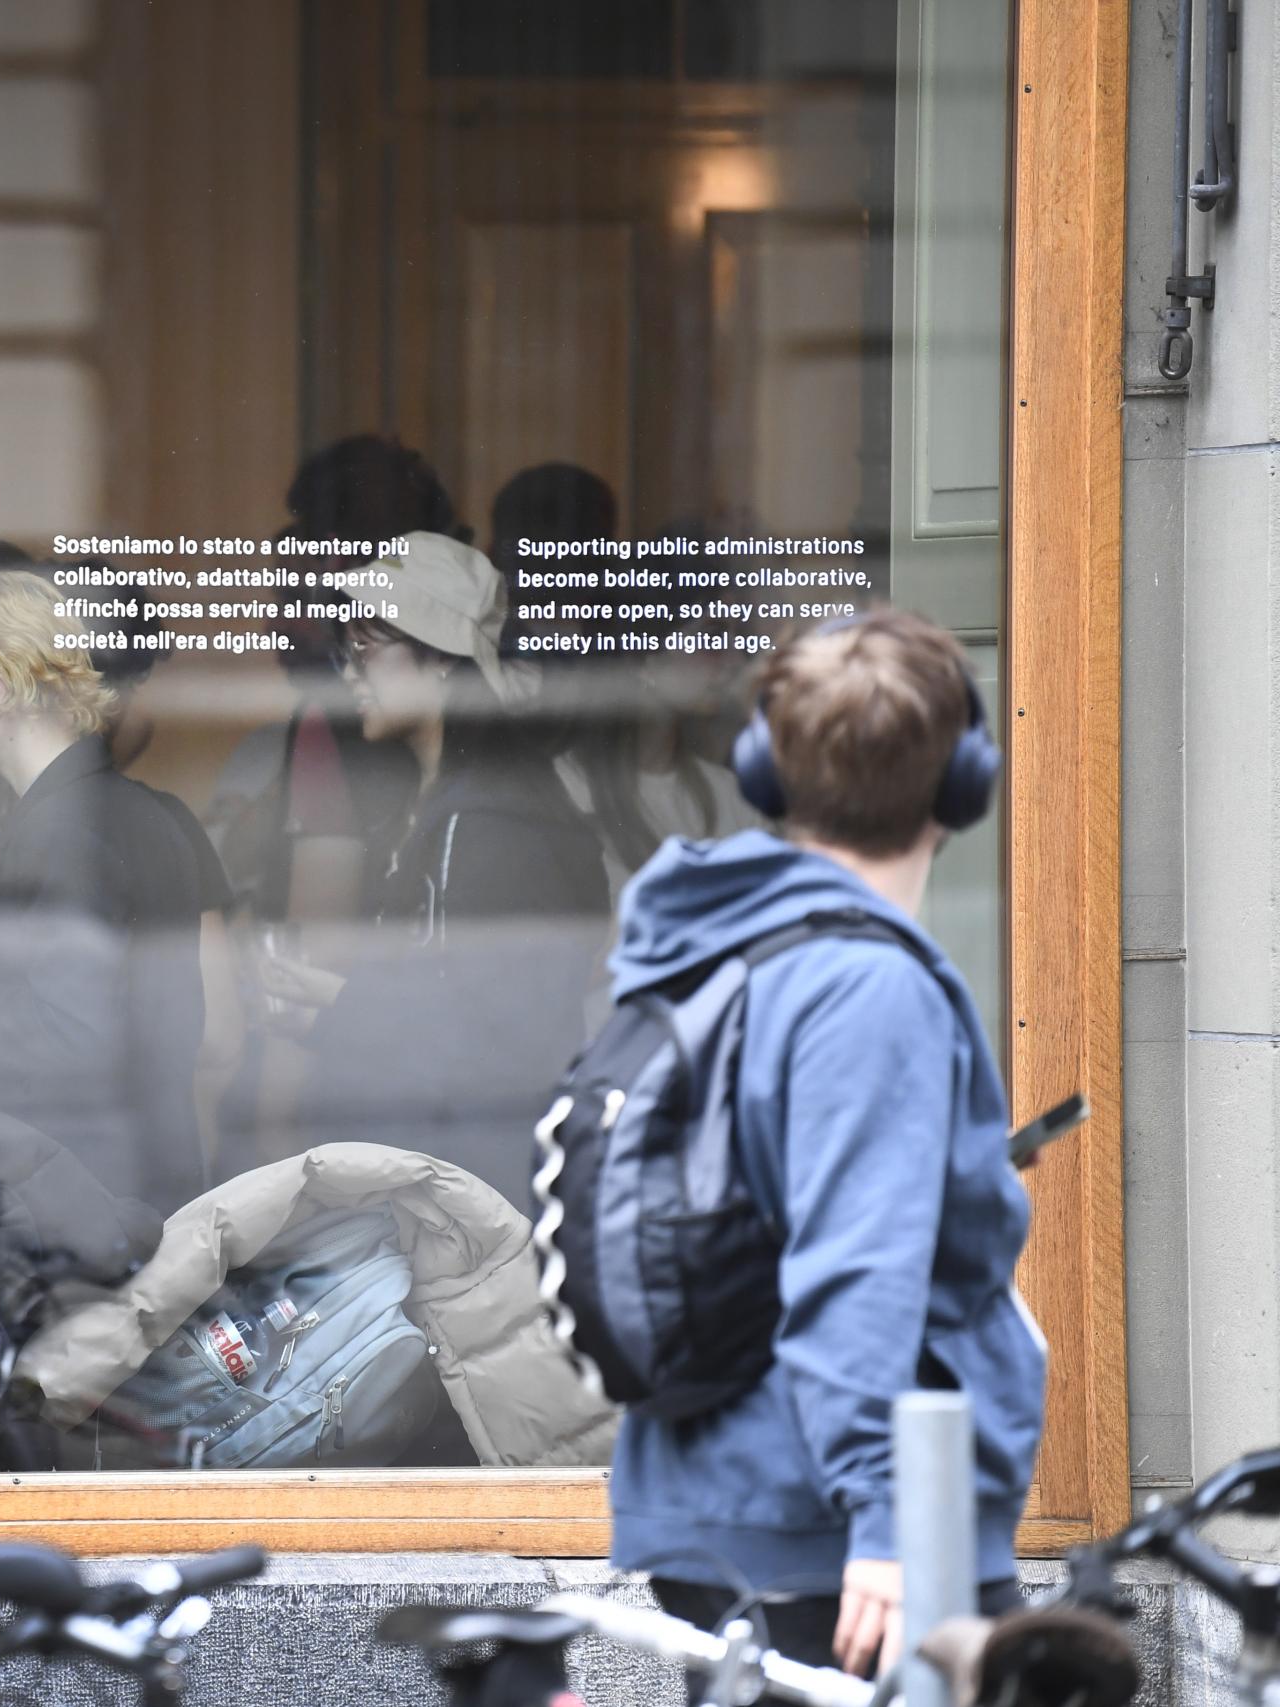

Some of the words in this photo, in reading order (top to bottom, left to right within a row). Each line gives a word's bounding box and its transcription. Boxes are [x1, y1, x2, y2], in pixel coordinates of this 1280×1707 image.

[53, 534, 174, 555] Sosteniamo
[179, 535, 198, 555] lo
[203, 537, 255, 555] stato
[260, 540, 272, 555] a
[277, 536, 373, 556] diventare
[378, 536, 410, 560] più
[518, 537, 631, 560] Supporting
[637, 536, 699, 559] public
[705, 536, 864, 555] administrations
[53, 566, 192, 589] collaborativo,
[196, 567, 300, 587] adattabile
[304, 572, 317, 587] e
[322, 569, 394, 591] aperto,
[518, 569, 599, 588] become
[604, 568, 673, 590] bolder,
[679, 572, 730, 587] more
[735, 568, 872, 589] collaborative,
[53, 598, 139, 618] affinché
[144, 603, 204, 622] possa
[209, 599, 279, 618] servire
[283, 599, 301, 619] al
[307, 599, 376, 623] meglio
[381, 599, 399, 619] la
[518, 600, 555, 619] and
[561, 604, 613, 619] more
[618, 604, 674, 622] open,
[679, 604, 703, 619] so
[708, 600, 755, 622] they
[758, 603, 794, 618] can
[799, 603, 855, 618] serve
[53, 630, 128, 650] società
[133, 630, 208, 650] nell'era
[213, 630, 295, 654] digitale.
[518, 632, 592, 655] society
[597, 632, 615, 650] in
[621, 632, 659, 650] this
[665, 631, 728, 654] digital
[734, 635, 776, 654] age.
